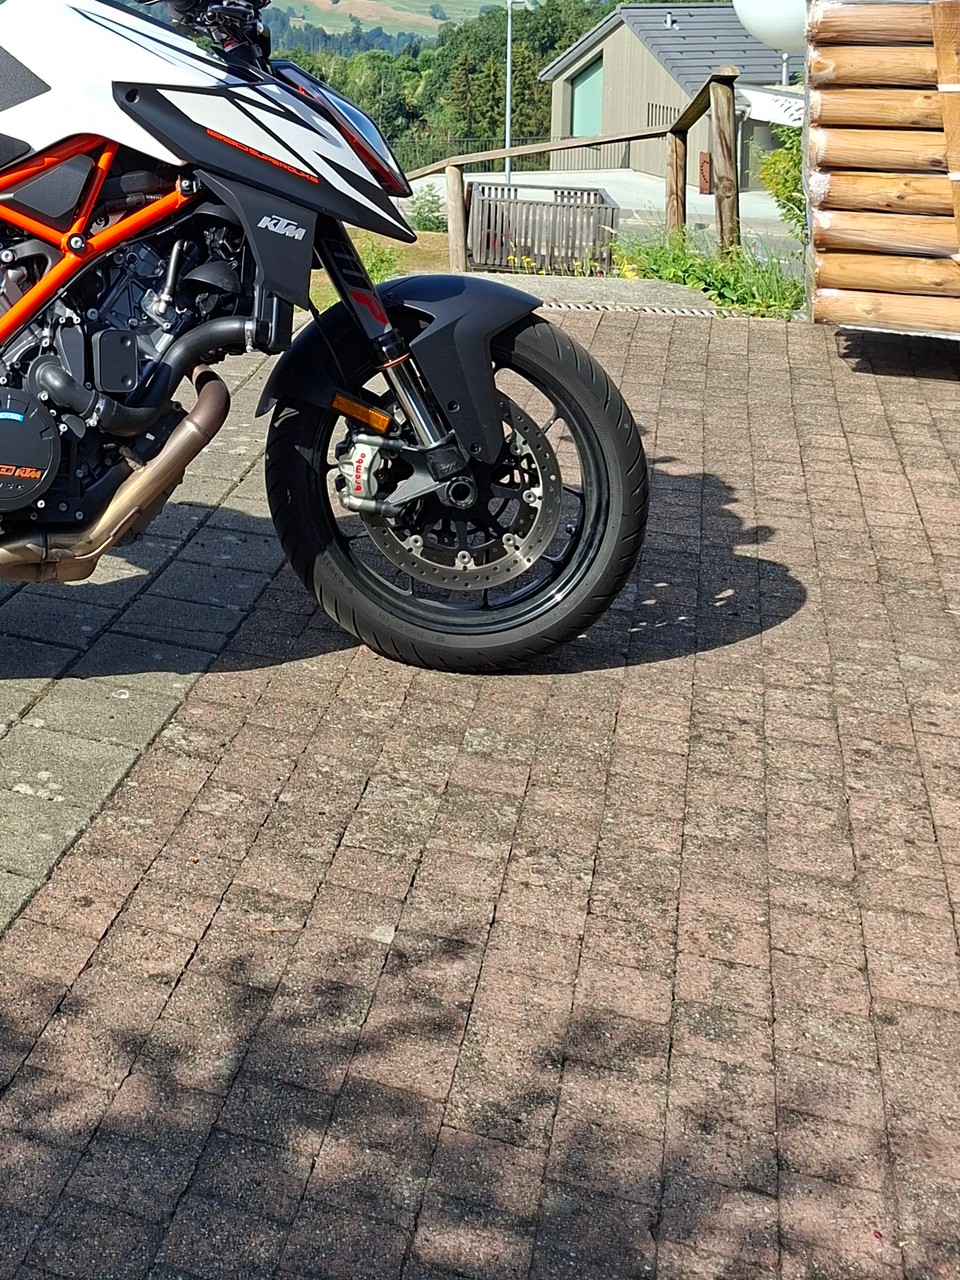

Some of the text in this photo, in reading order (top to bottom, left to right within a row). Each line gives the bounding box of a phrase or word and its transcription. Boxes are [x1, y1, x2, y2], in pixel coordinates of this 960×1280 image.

[257, 214, 306, 241] KTM
[14, 467, 41, 479] KTM
[353, 453, 366, 493] brembo
